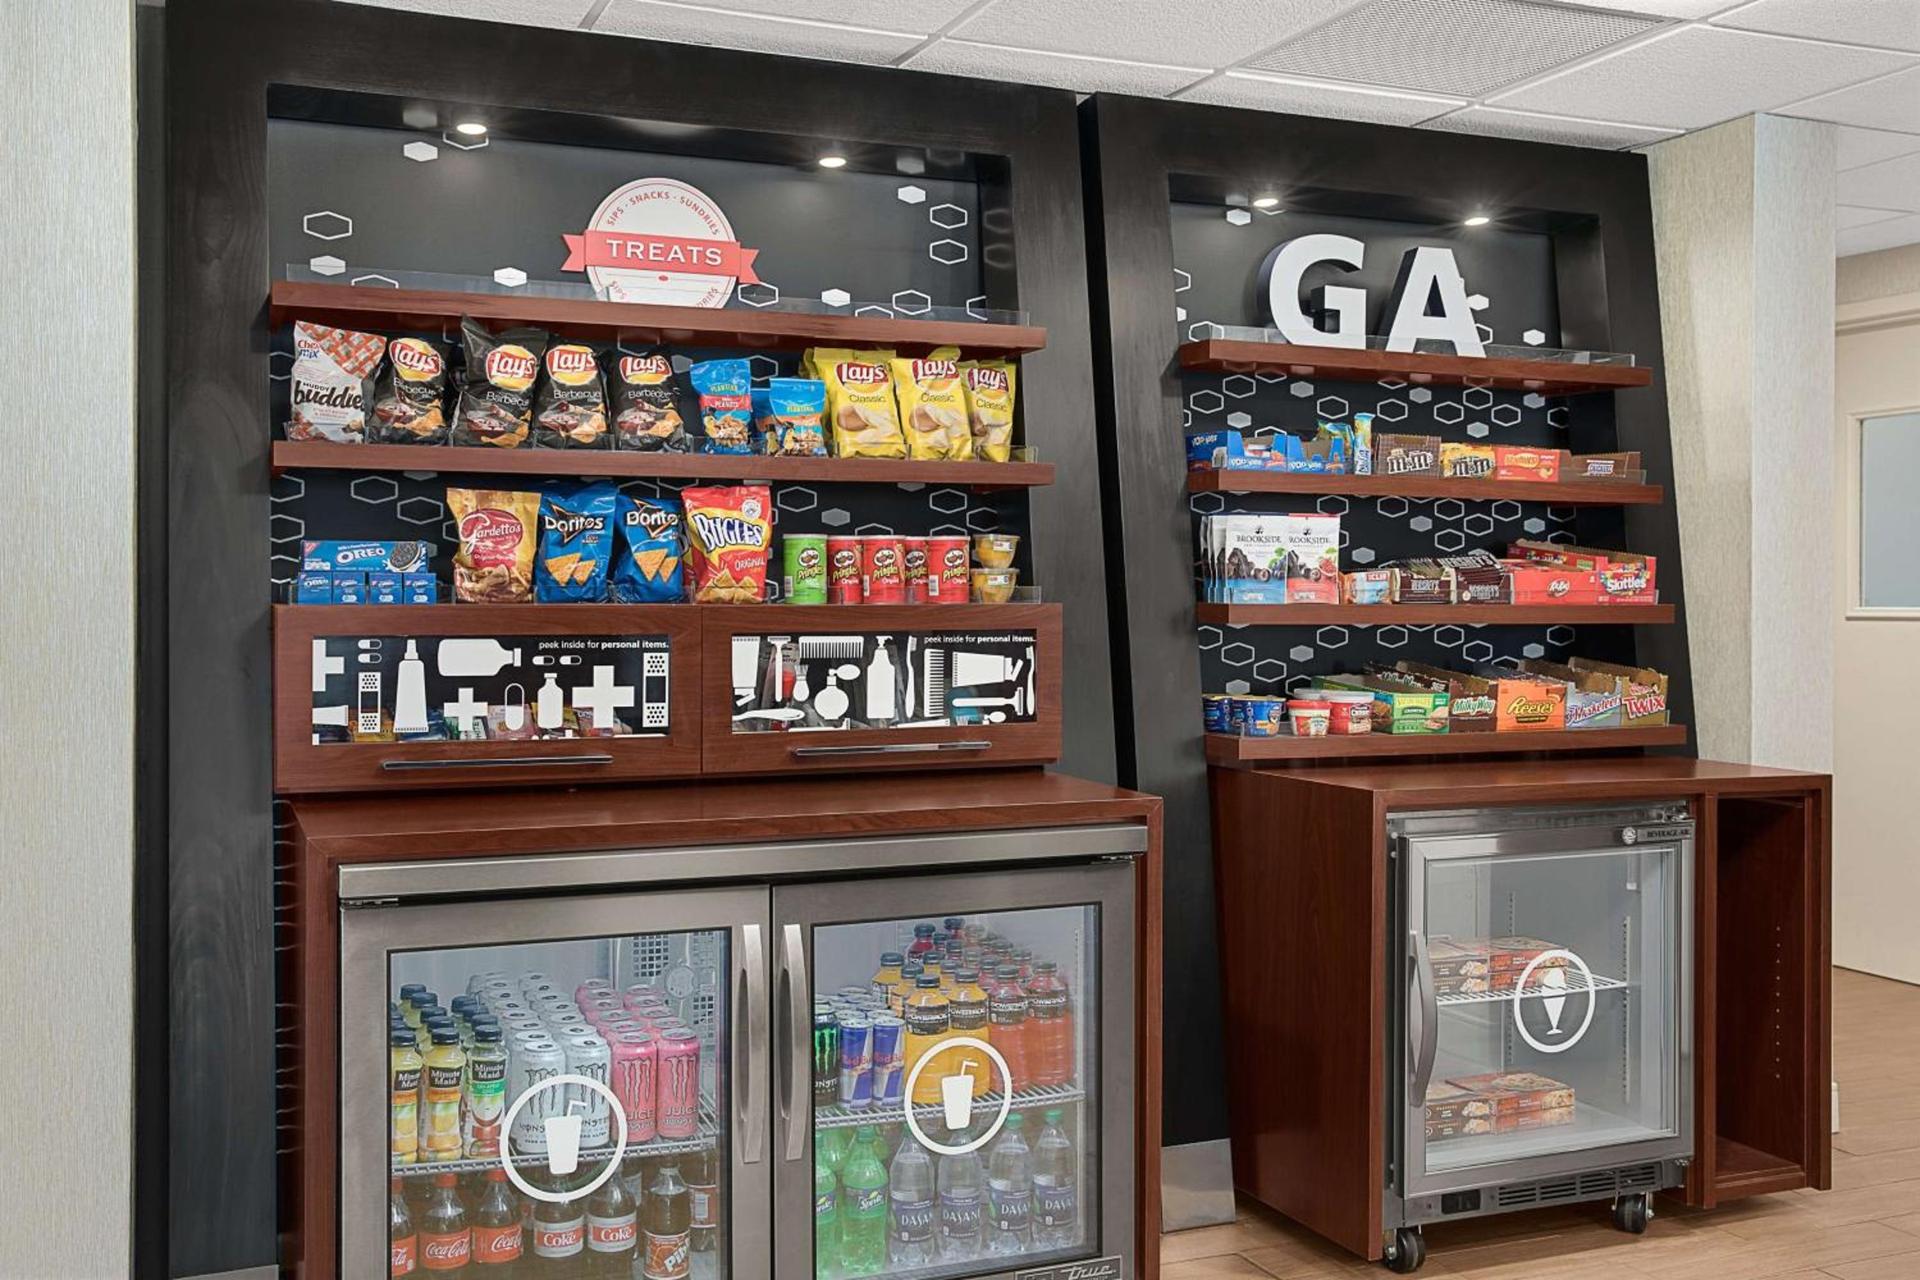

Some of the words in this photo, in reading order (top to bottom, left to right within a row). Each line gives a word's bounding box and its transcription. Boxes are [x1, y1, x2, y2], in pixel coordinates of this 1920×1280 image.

[607, 206, 624, 226] SIPS
[629, 191, 670, 206] SNACKS
[680, 196, 720, 236] SUNDRIES
[606, 239, 722, 266] TREATS
[393, 342, 439, 374] Lay's
[491, 352, 535, 379] Lay's
[551, 349, 596, 374] Lay's
[626, 355, 667, 377] Lay's
[841, 363, 888, 384] Lay's
[916, 359, 958, 382] Lay's
[970, 367, 1008, 392] Lay's
[848, 393, 886, 404] Classic
[544, 515, 604, 532] Doritos
[626, 510, 679, 527] Dorito
[692, 512, 764, 553] BUGLES
[1236, 534, 1282, 544] BROOKSIDE
[336, 547, 386, 565] OREO
[1606, 575, 1647, 592] Skittles
[538, 640, 560, 650] peek
[561, 640, 586, 649] inside
[587, 640, 600, 649] for
[601, 640, 641, 651] personal
[641, 640, 670, 649] items.
[924, 634, 942, 645] peek
[943, 635, 964, 643] inside
[964, 634, 977, 643] for
[977, 634, 1011, 645] personal
[1011, 635, 1037, 643] items.
[431, 1070, 461, 1079] Minute
[543, 1230, 576, 1247] Coke
[600, 1226, 632, 1242] Coke
